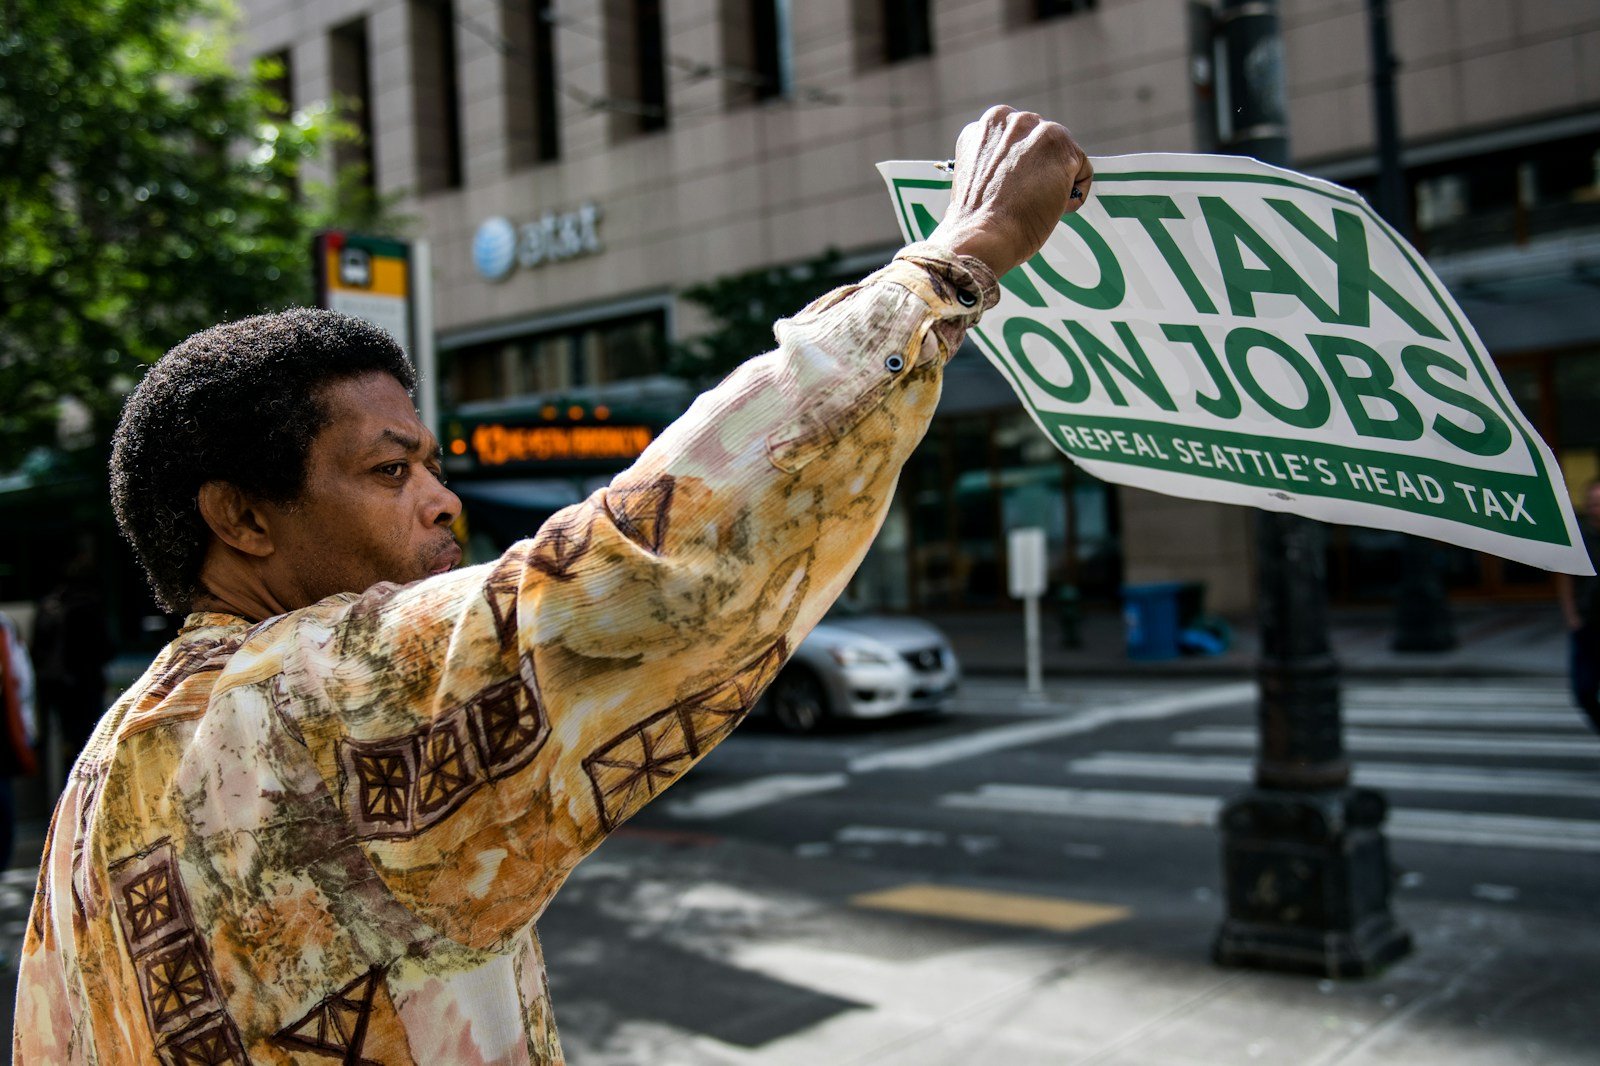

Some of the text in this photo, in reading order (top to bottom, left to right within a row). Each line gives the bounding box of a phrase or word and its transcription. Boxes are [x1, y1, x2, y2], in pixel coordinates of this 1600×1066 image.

[910, 194, 1450, 342] O TAX
[1002, 316, 1513, 457] ON JOBS
[1058, 424, 1537, 525] REPEAL SEATTLE’S HEAD TAX
